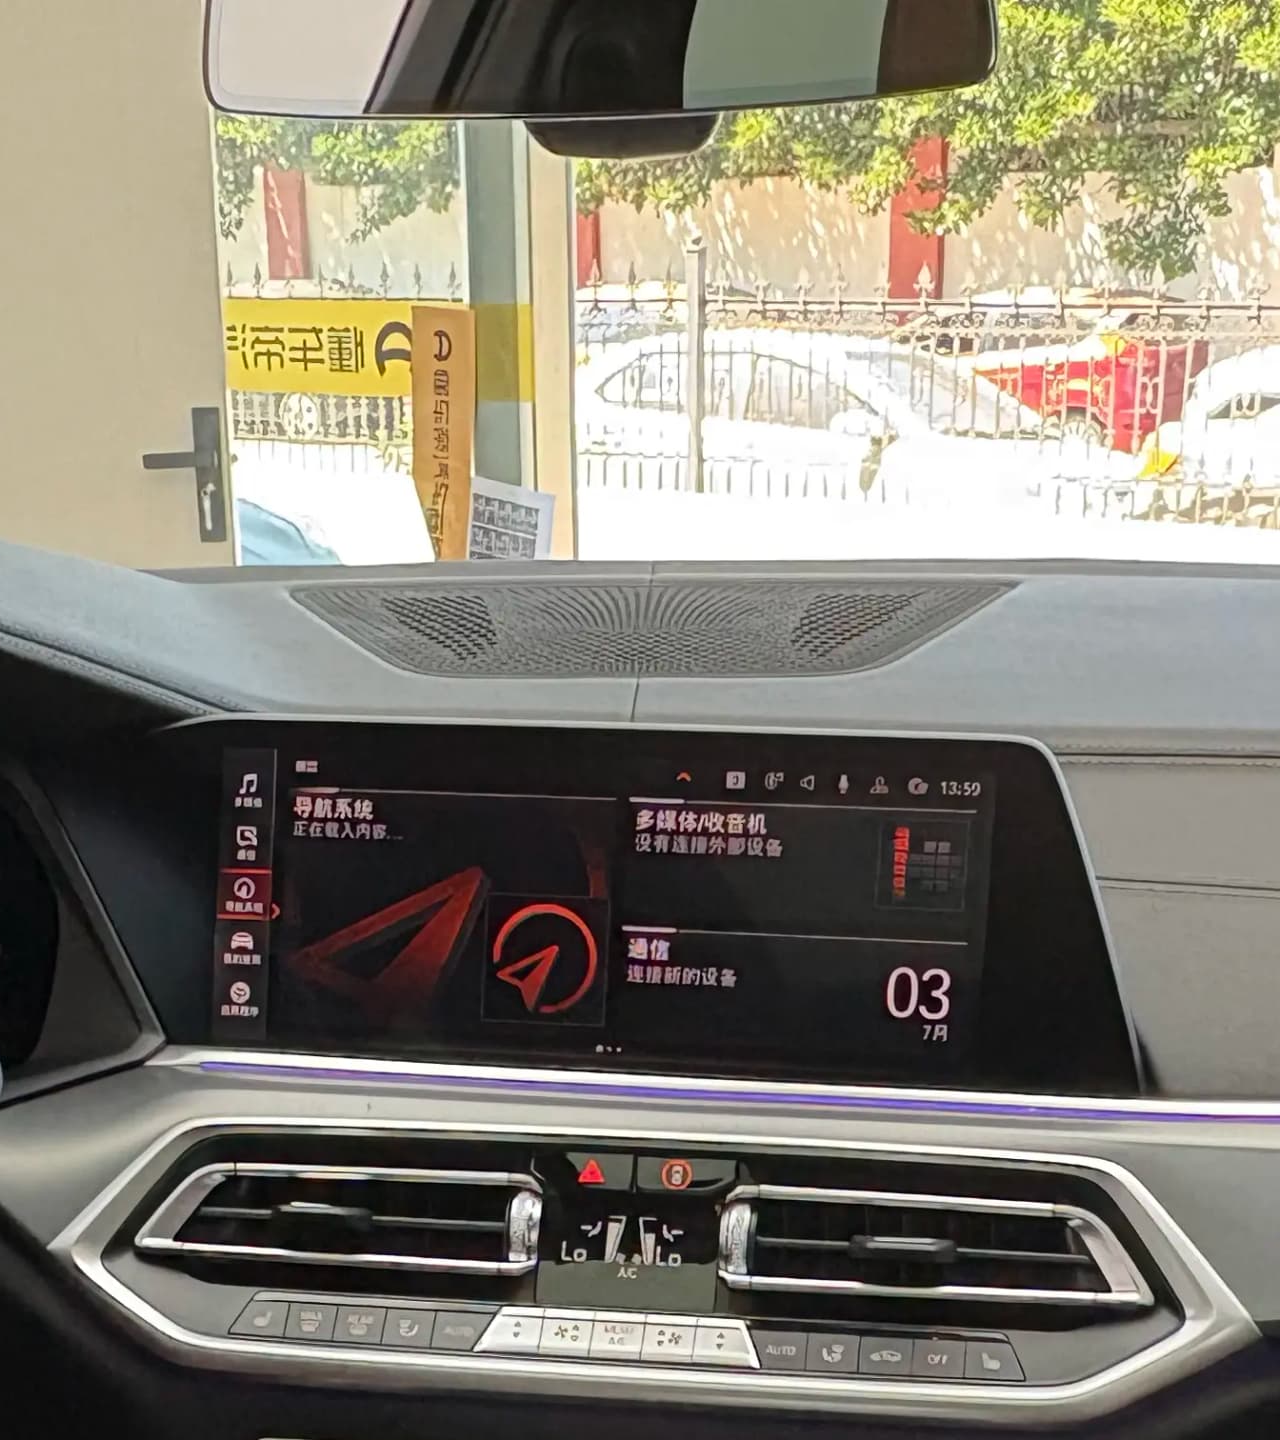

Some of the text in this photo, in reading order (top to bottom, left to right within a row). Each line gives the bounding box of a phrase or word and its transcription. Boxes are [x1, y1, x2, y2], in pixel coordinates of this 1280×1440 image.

[940, 781, 982, 797] 13:59
[293, 796, 374, 820] 导航系统
[635, 809, 767, 835] 多媒体/收音机
[886, 966, 951, 1020] 03
[922, 1024, 949, 1043] 7月
[765, 1344, 797, 1356] AUTO
